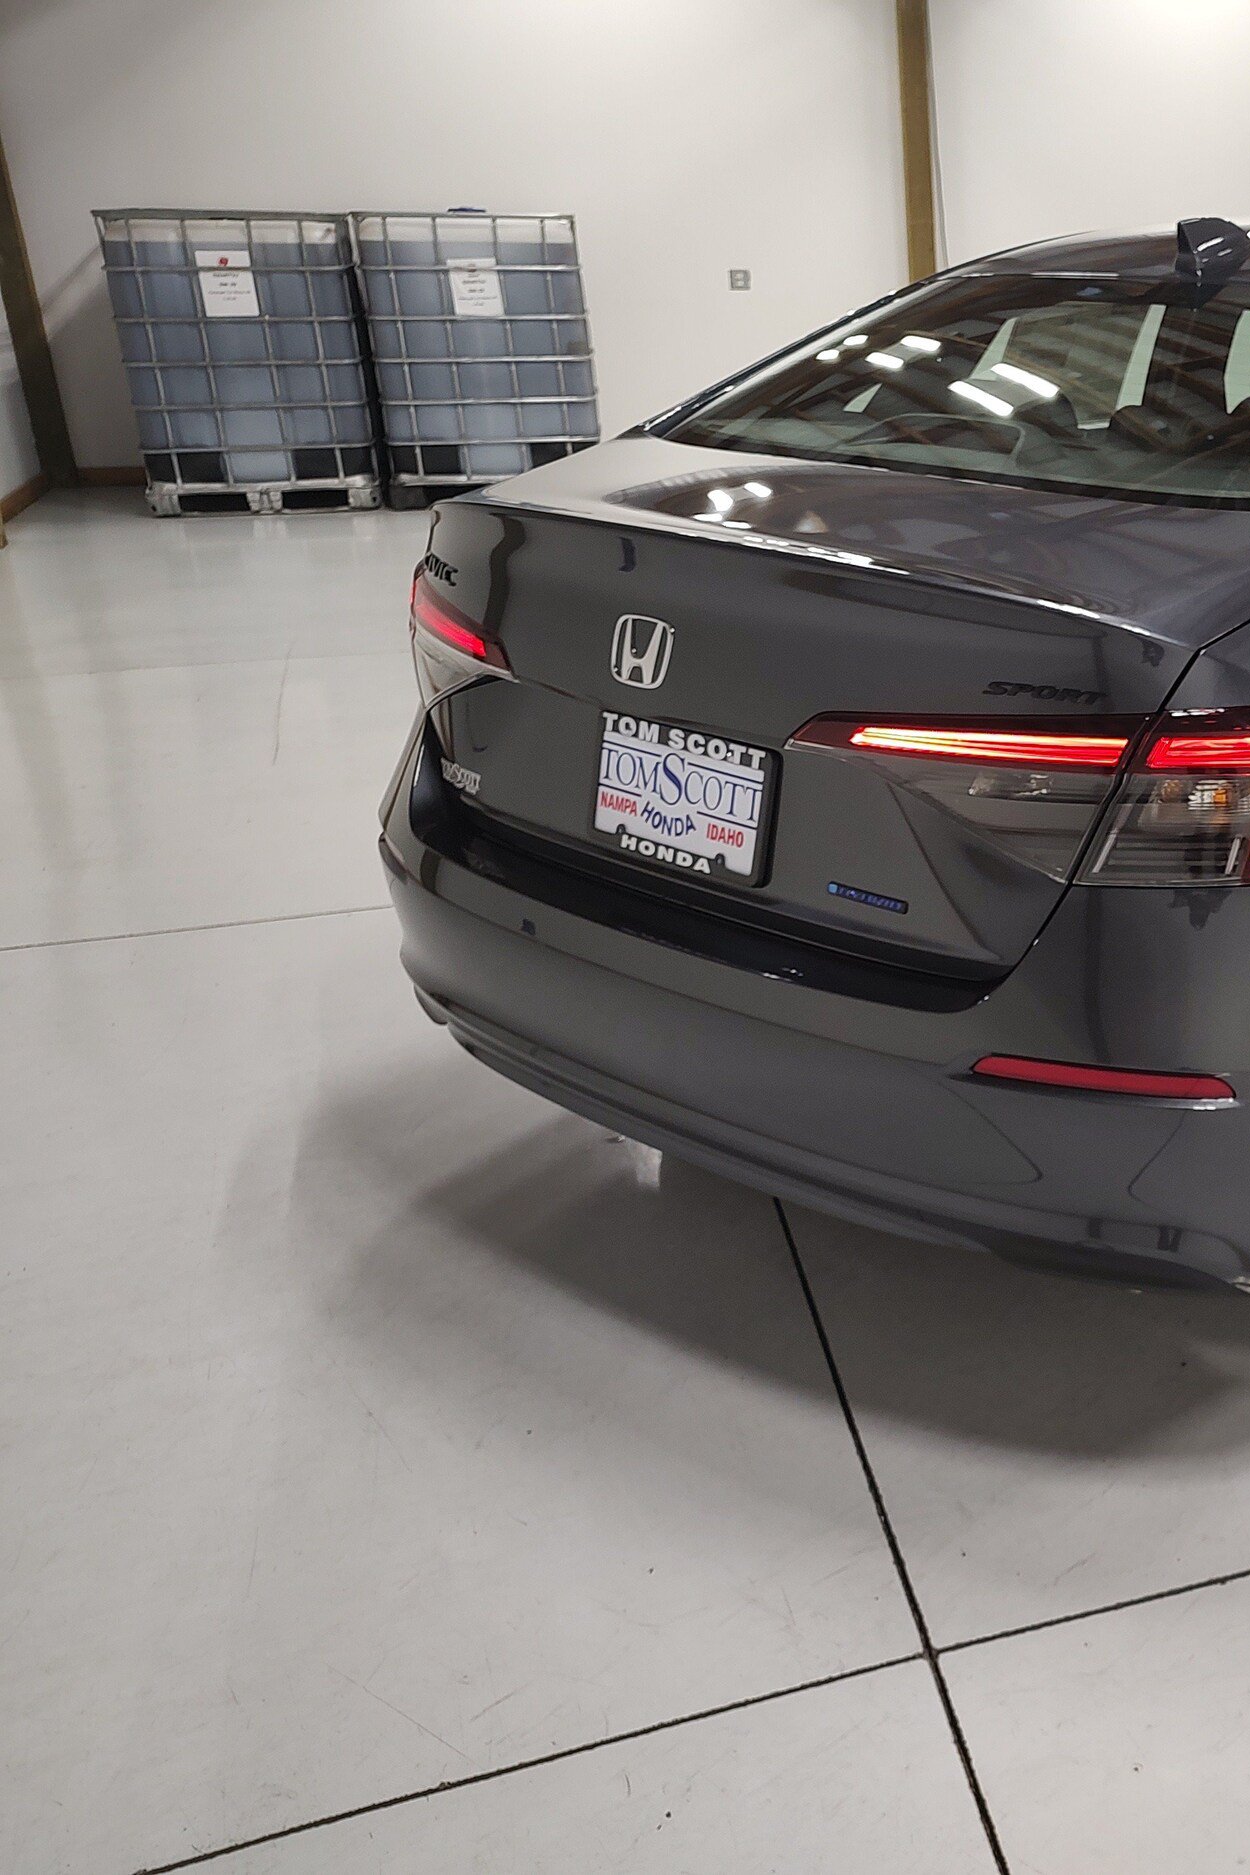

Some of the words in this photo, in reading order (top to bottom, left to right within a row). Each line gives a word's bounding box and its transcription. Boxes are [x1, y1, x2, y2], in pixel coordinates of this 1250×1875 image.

[982, 681, 1107, 705] SPORT
[602, 711, 660, 744] TOM
[667, 728, 766, 771] SCOTT
[600, 791, 638, 817] NAMPA
[640, 801, 697, 837] HONDA
[705, 823, 744, 848] IDAHO
[620, 834, 712, 875] HONDA
